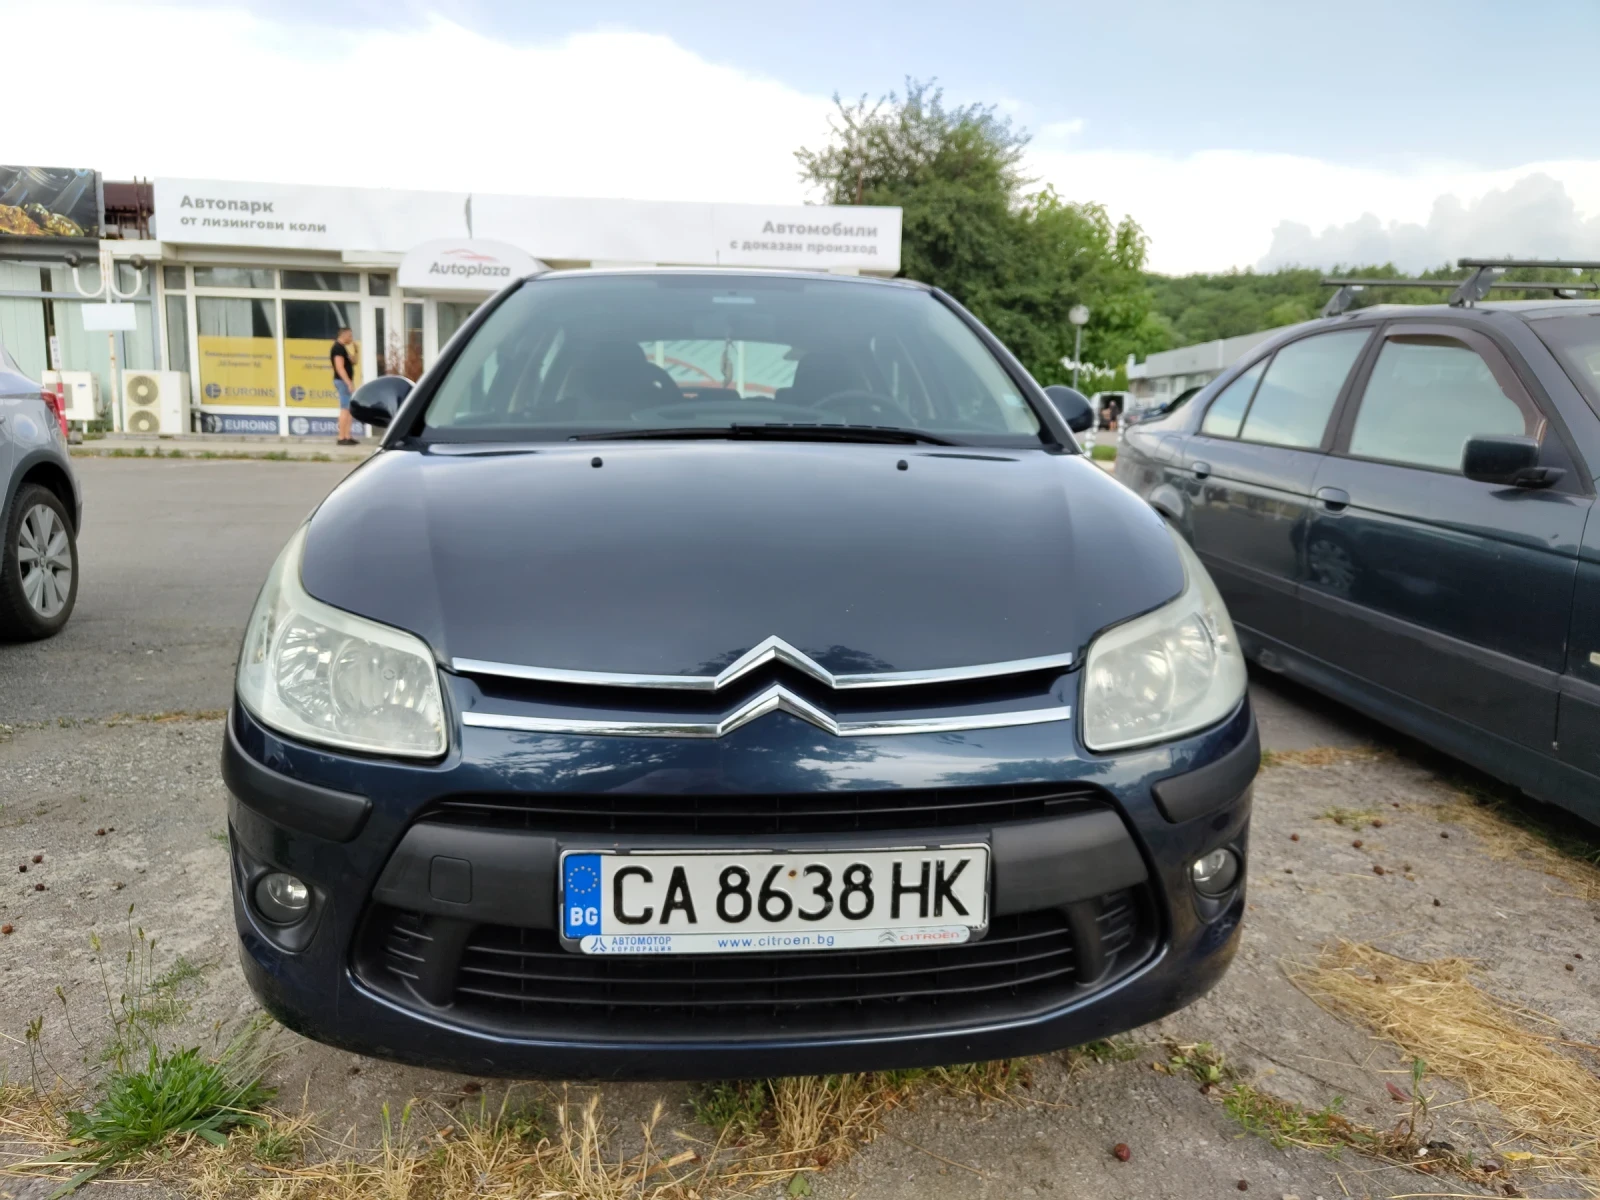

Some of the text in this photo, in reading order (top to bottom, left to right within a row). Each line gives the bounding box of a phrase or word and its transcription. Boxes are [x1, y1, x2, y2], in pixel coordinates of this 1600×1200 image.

[180, 195, 274, 214] Автопарк
[180, 216, 327, 233] от лизингови коли
[762, 220, 878, 238] Автомобили
[729, 240, 878, 256] с доказан произход
[429, 261, 510, 278] Autoplaza
[224, 386, 276, 398] EUROINS
[224, 418, 278, 431] EUROINS
[613, 859, 970, 925] CA 8638 HK
[569, 906, 599, 927] BG
[611, 936, 672, 946] АВТОМОТОР
[611, 945, 673, 953] КОРПОРАЦИЯ
[717, 935, 836, 948] www.citroen.bg
